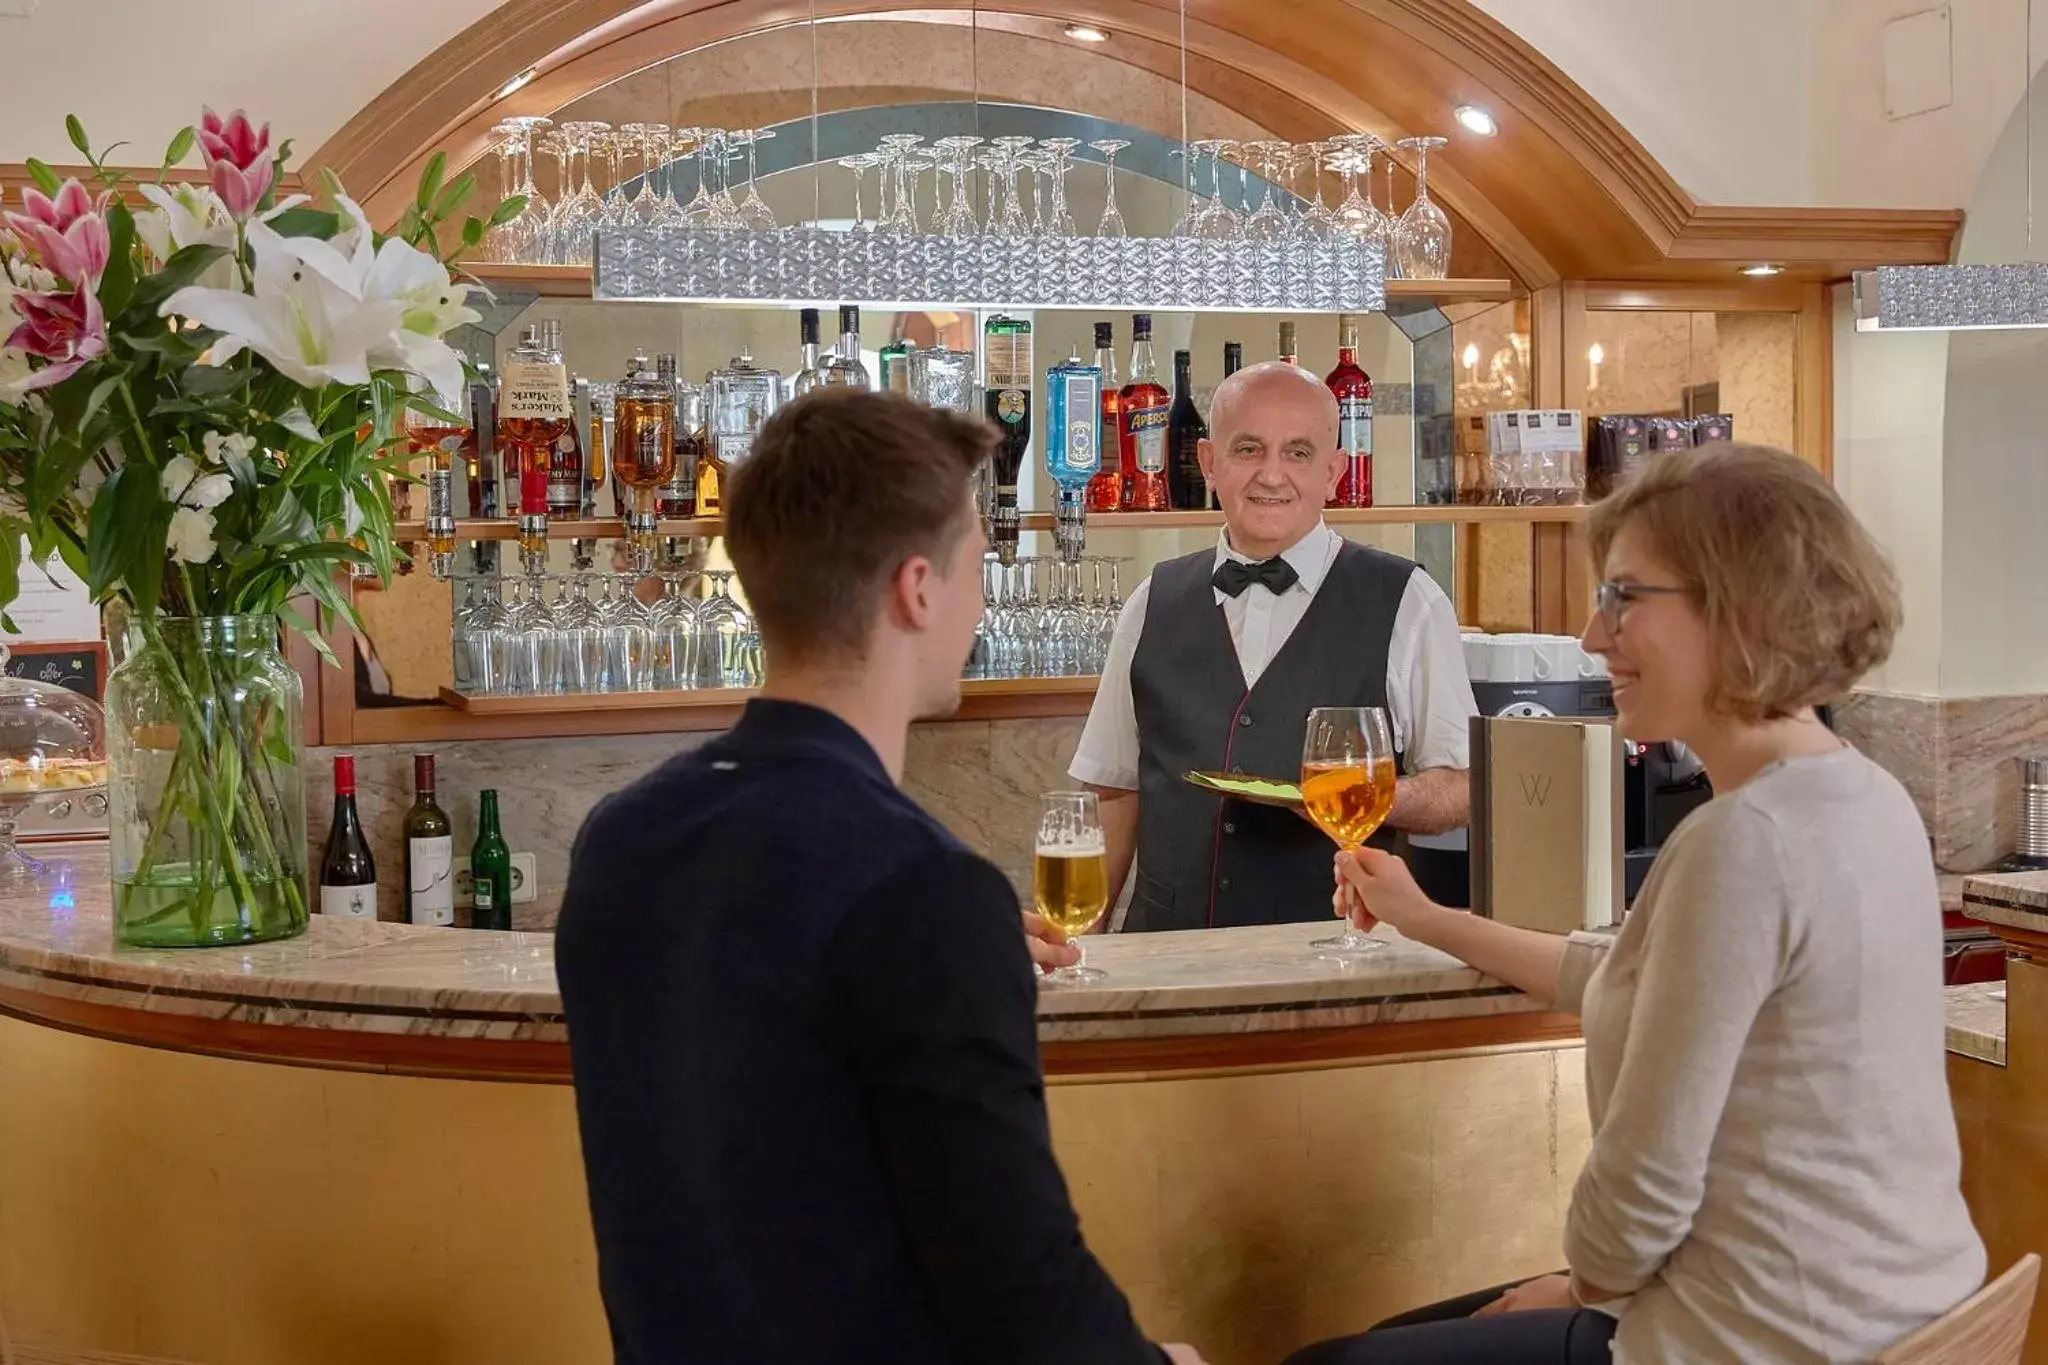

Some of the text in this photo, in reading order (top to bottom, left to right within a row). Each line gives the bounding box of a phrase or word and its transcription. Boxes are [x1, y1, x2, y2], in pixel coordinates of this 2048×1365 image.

[511, 391, 549, 402] Mark
[511, 403, 563, 413] Maker's
[39, 661, 64, 680] offer
[1519, 773, 1551, 806] W
